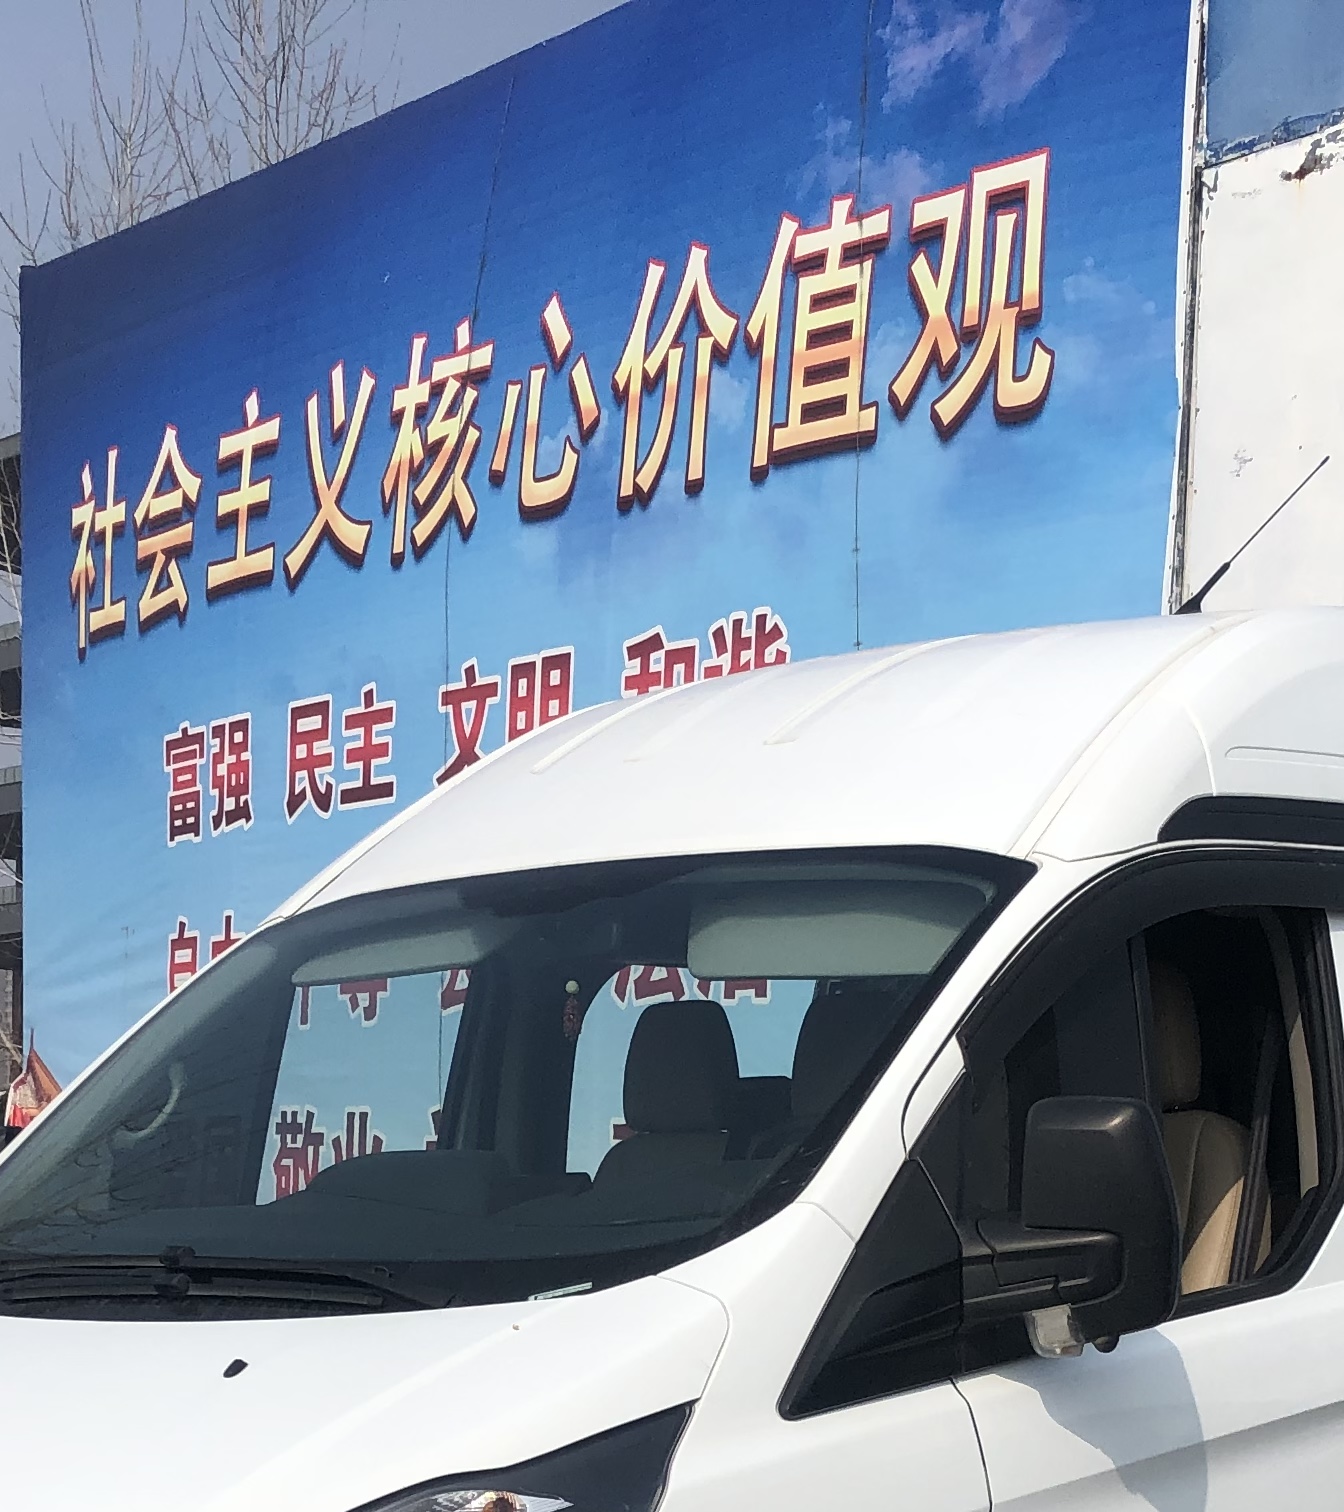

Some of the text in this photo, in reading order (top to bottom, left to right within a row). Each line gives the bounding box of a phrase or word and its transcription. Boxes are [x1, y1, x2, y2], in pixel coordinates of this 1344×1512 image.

[69, 147, 1056, 660] 社会主义核心价值观
[164, 714, 254, 846] 富强
[284, 682, 397, 822] 民主
[433, 646, 575, 786] 文明
